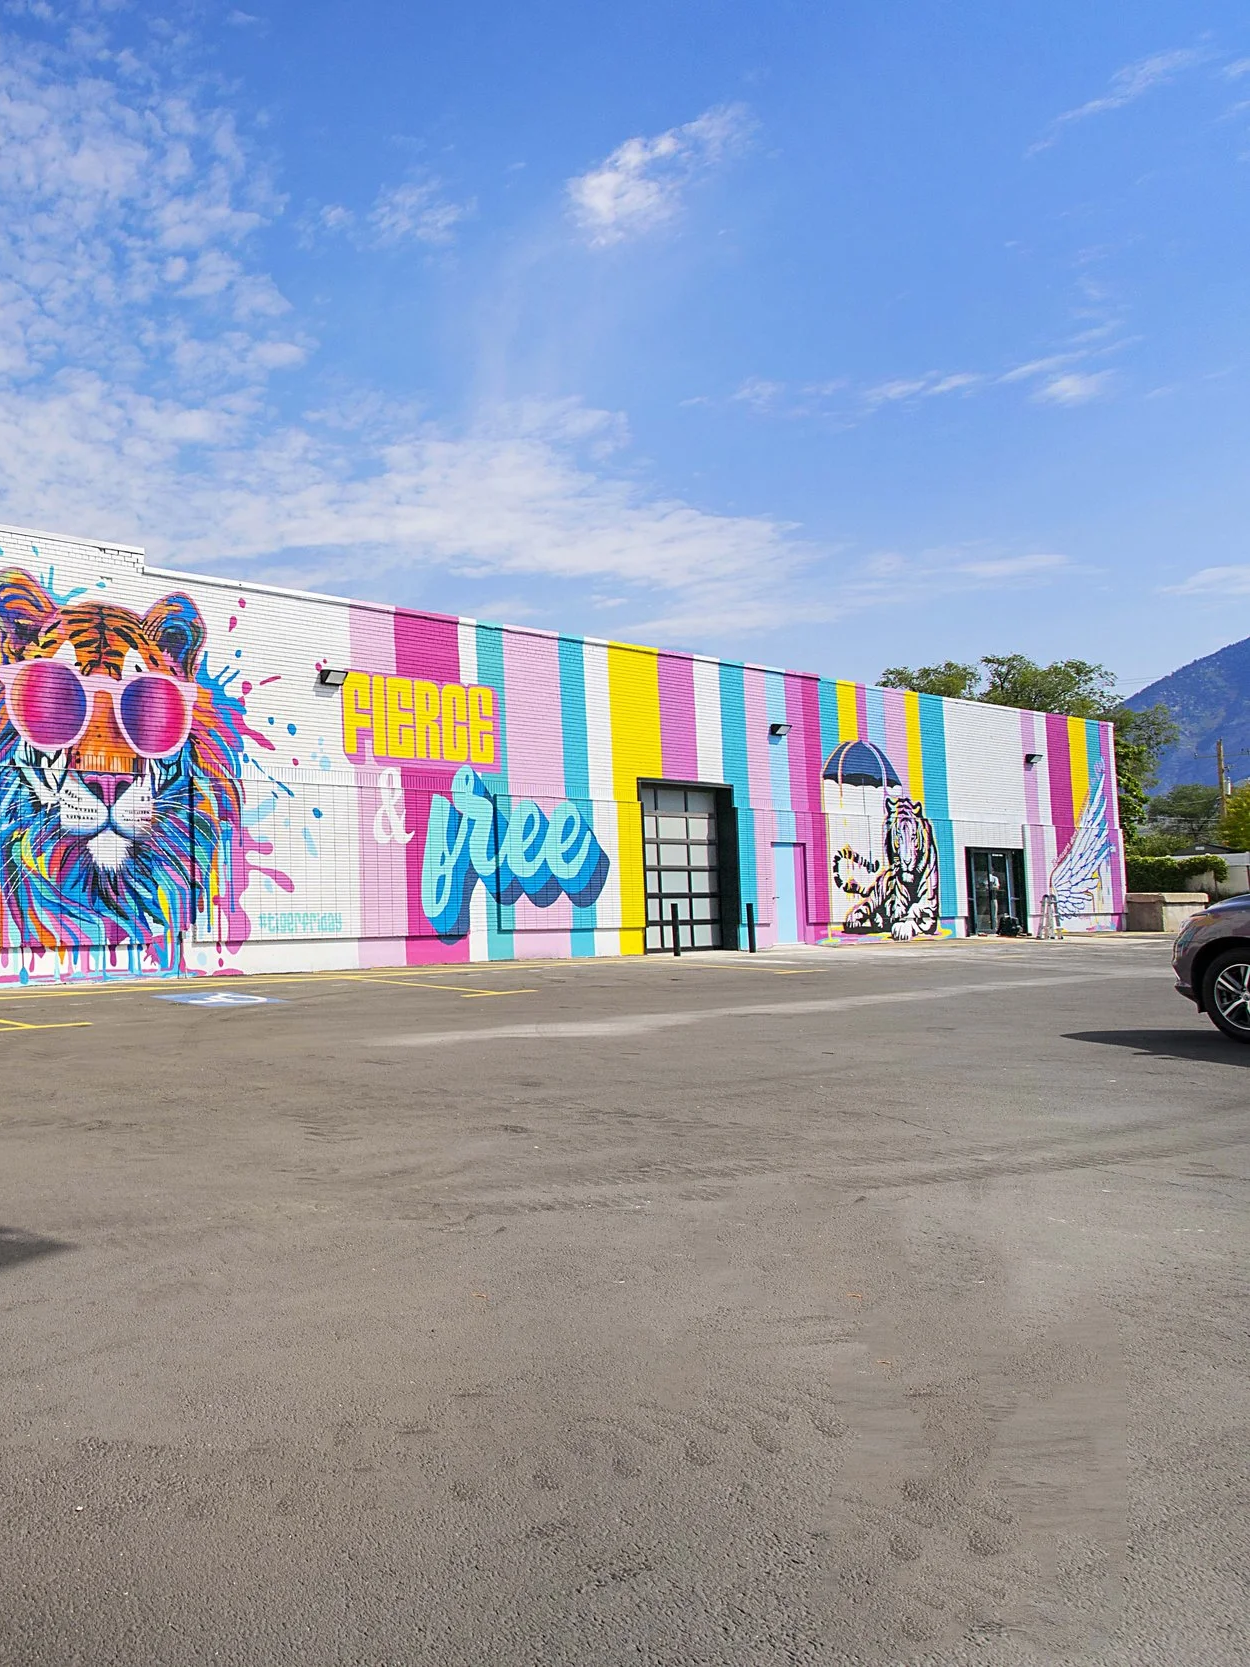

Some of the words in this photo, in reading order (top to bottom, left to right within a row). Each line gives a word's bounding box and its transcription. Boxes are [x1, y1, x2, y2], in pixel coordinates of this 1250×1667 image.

[341, 670, 499, 768] FIERCE
[373, 766, 416, 846] &
[421, 764, 607, 938] free
[258, 912, 342, 933] #tigerfriday
